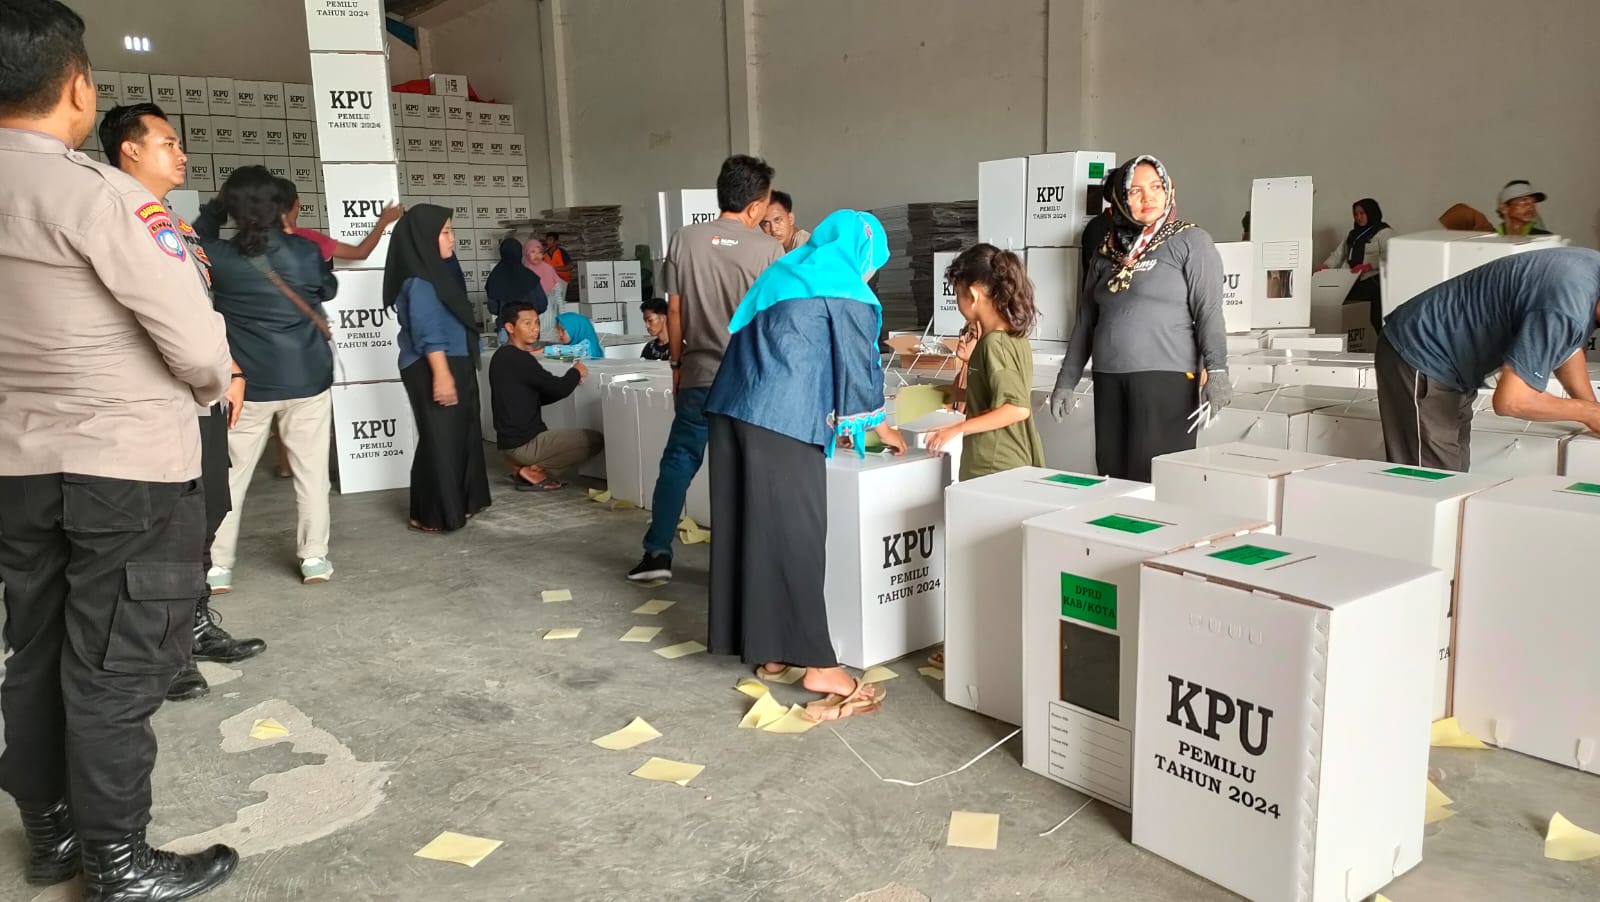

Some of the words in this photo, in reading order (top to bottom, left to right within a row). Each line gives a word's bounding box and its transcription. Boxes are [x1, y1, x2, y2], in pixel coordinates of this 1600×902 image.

[97, 84, 115, 92] KPU
[127, 86, 145, 94] KPU
[158, 88, 174, 96] KPU
[186, 89, 202, 97] KPU
[213, 90, 229, 98] KPU
[290, 95, 305, 103] KPU
[330, 90, 373, 110] KPU
[191, 128, 206, 136] KPU
[242, 130, 257, 138] KPU
[267, 131, 281, 139] KPU
[296, 168, 310, 176] KPU
[1037, 186, 1064, 202] KPU
[342, 200, 384, 218] KPU
[338, 309, 384, 328] KPU
[352, 419, 396, 439] KPU
[883, 525, 935, 568] KPU
[890, 567, 929, 585] PEMILU
[878, 585, 913, 604] TAHUN
[917, 579, 941, 594] 2024
[1075, 584, 1102, 599] DPRD
[1063, 595, 1115, 618] KAB/KOTA
[1166, 675, 1273, 756] KPU
[1178, 740, 1256, 783] PEMILU
[1154, 754, 1221, 794] TAHUN
[1228, 786, 1281, 819] 2024
